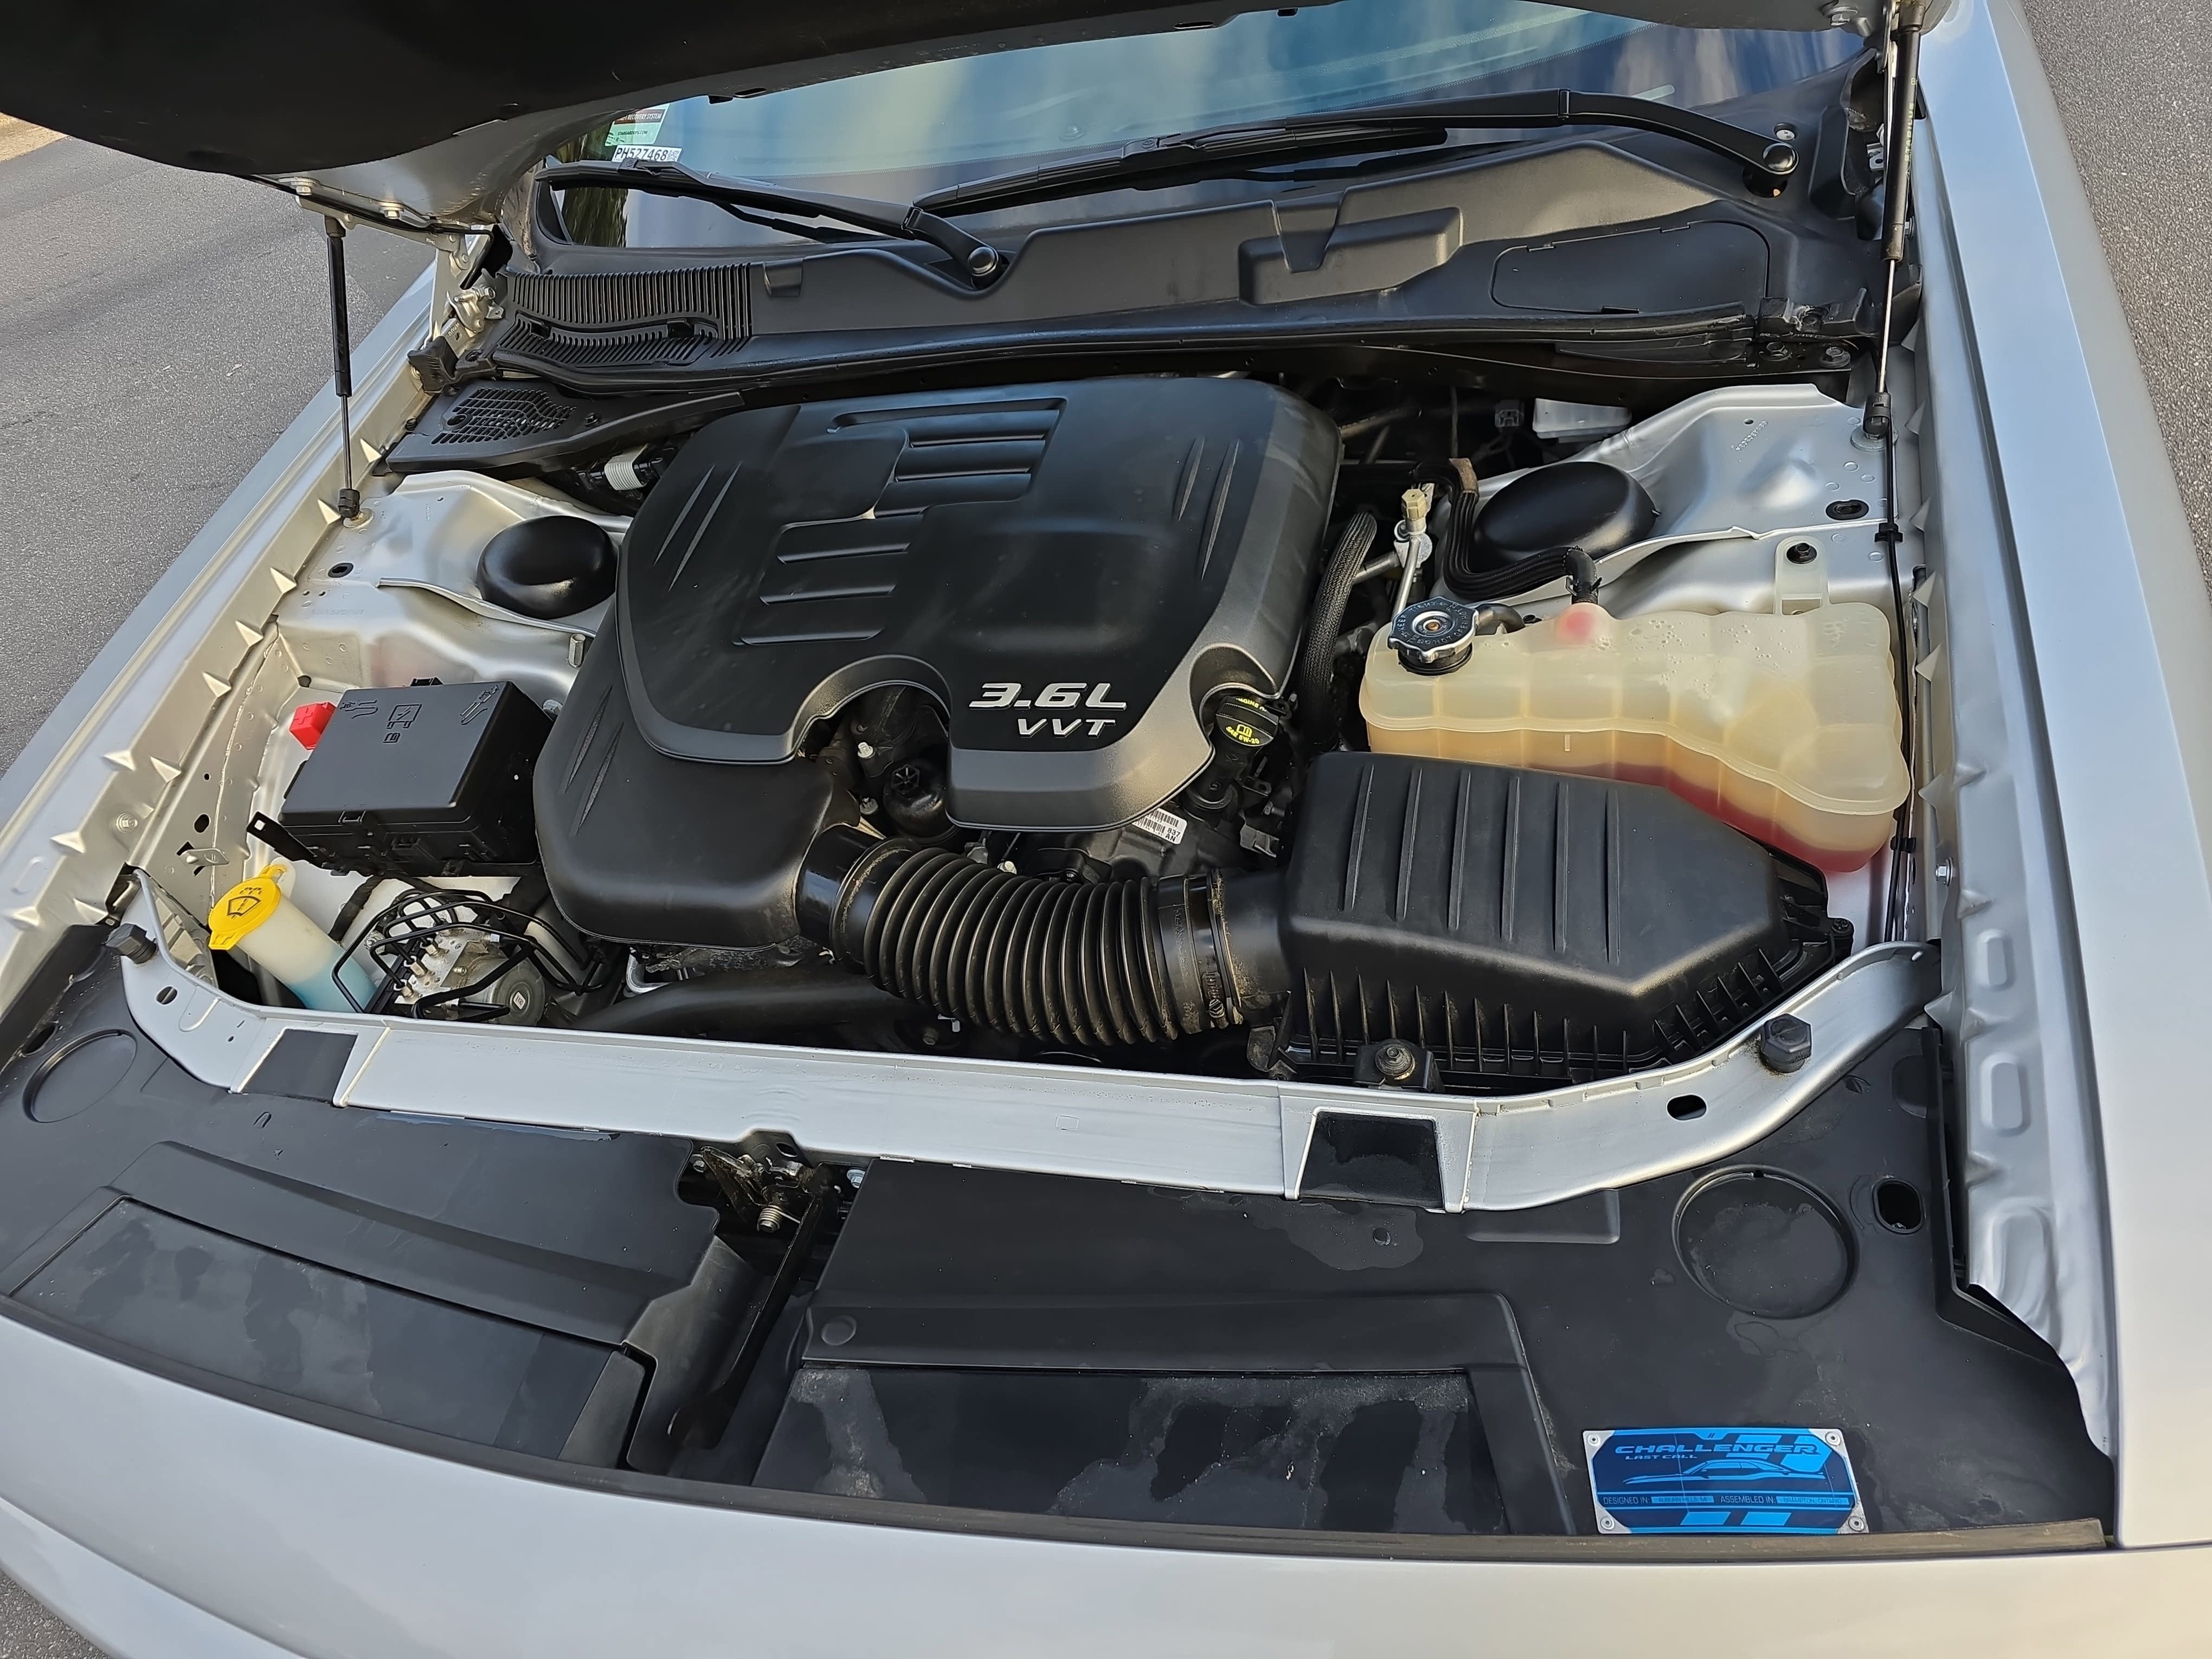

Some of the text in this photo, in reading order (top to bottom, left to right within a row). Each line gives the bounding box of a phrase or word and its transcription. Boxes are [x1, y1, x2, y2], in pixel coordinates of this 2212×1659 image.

[1905, 102, 1914, 162] STABILUS
[615, 147, 668, 160] PH527468
[969, 683, 1127, 710] 3.6L
[1018, 718, 1116, 738] VVT
[1226, 726, 1239, 738] SAE
[1165, 833, 1176, 842] AN
[1167, 827, 1181, 838] 837
[1615, 1443, 1822, 1455] CHALLENGER
[1603, 1496, 1638, 1504] DESIGNED
[1640, 1496, 1650, 1504] IN:
[1766, 1496, 1777, 1504] IN:
